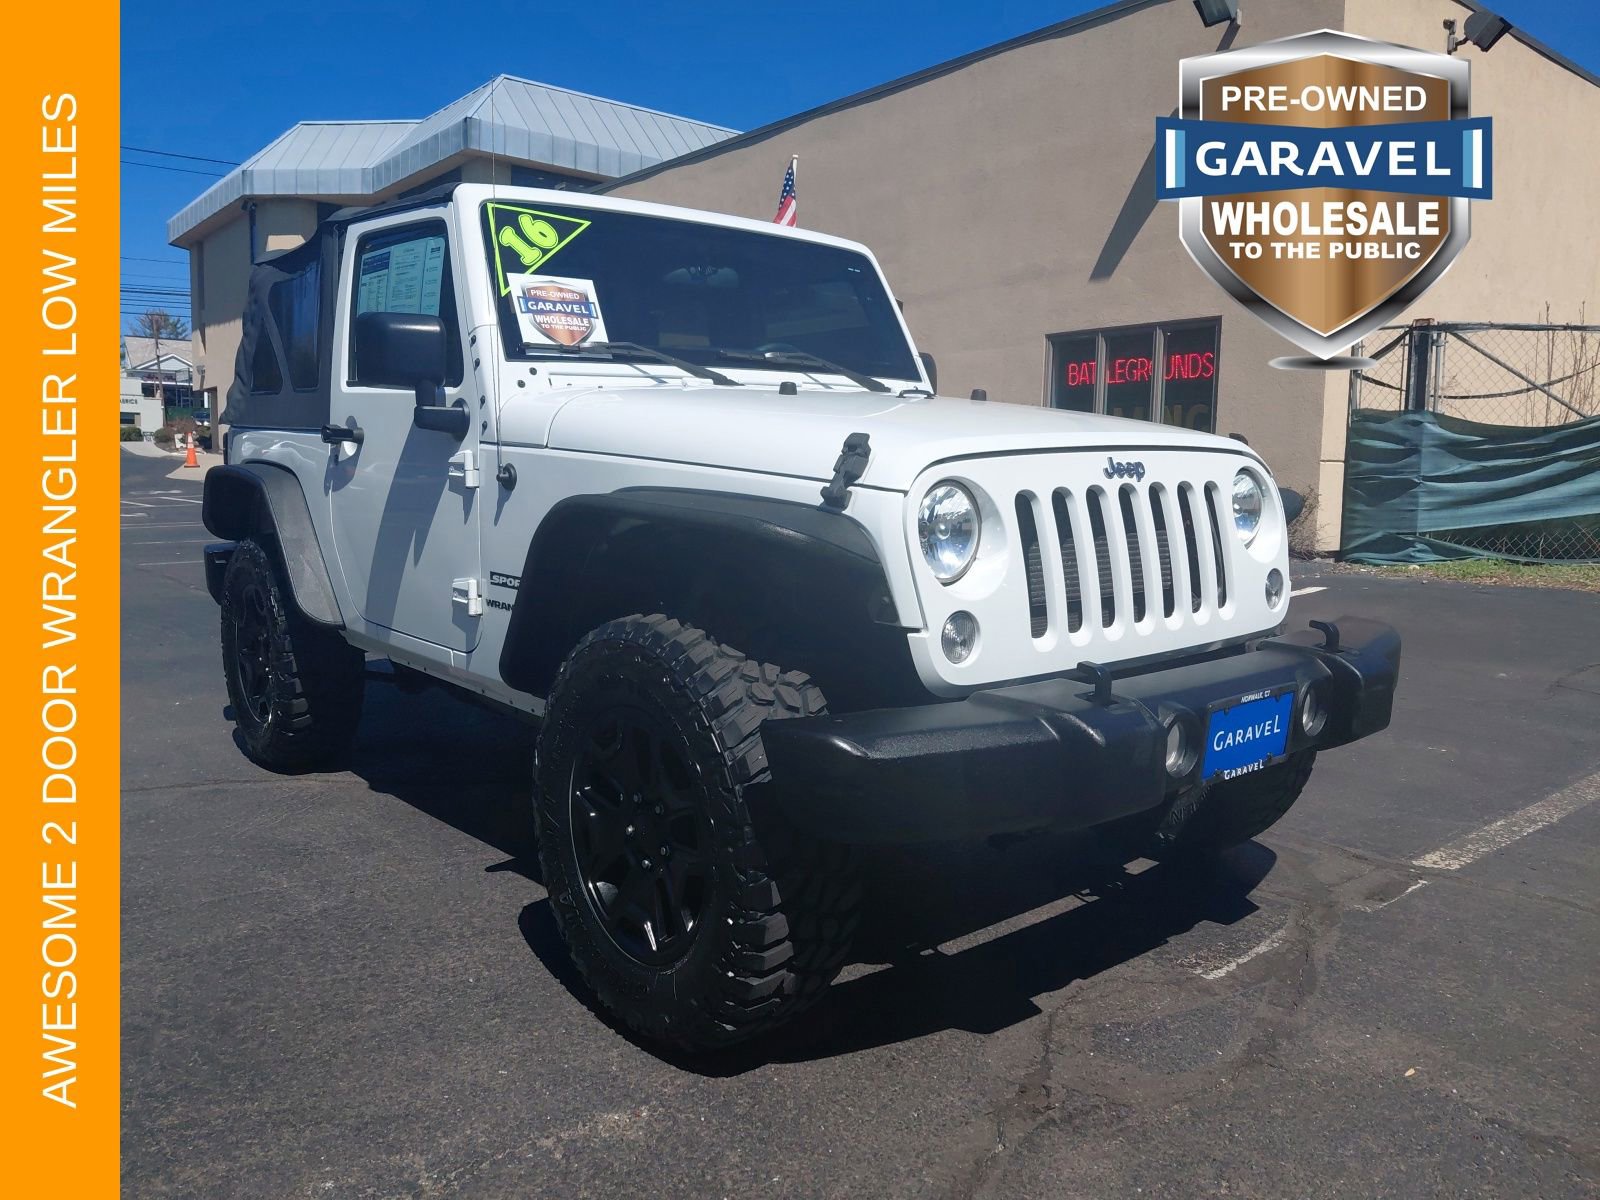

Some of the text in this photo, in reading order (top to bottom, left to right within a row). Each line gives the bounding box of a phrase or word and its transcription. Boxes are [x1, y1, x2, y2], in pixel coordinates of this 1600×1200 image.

[499, 213, 559, 265] 16
[530, 289, 580, 300] PRE-OWNED
[527, 301, 590, 314] GARAVEL
[534, 314, 590, 327] WHOLESALE
[1067, 351, 1215, 387] BATLEGRUNDS
[1103, 456, 1146, 482] Jeep
[1214, 715, 1280, 751] GARAVEL
[1224, 759, 1264, 780] GARAVEL
